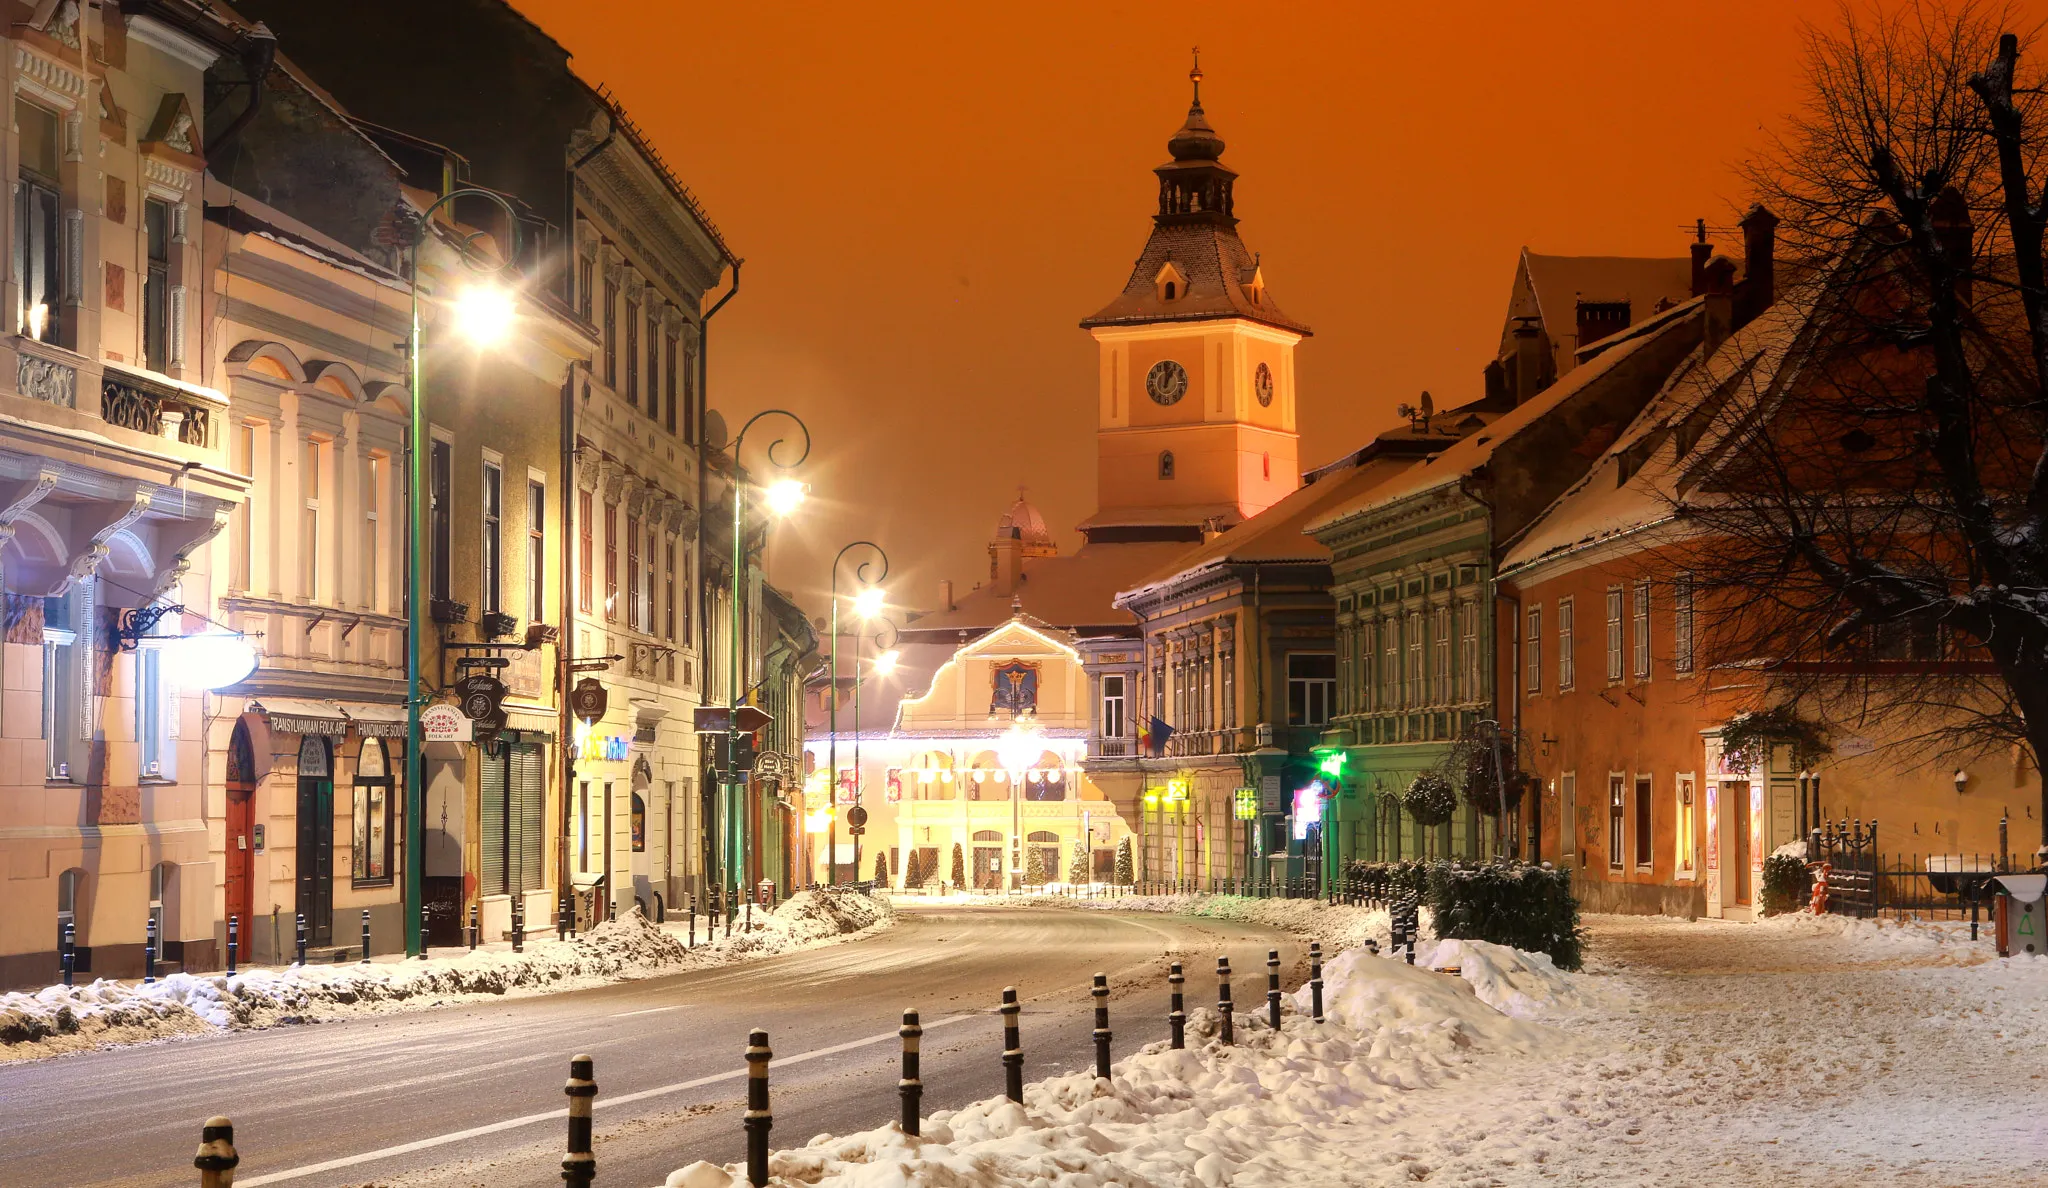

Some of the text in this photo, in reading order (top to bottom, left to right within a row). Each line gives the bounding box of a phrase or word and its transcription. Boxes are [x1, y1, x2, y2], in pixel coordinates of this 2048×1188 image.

[270, 716, 347, 735] TRANSYLVANIAN FOLK ART
[358, 722, 389, 737] HANDMADE
